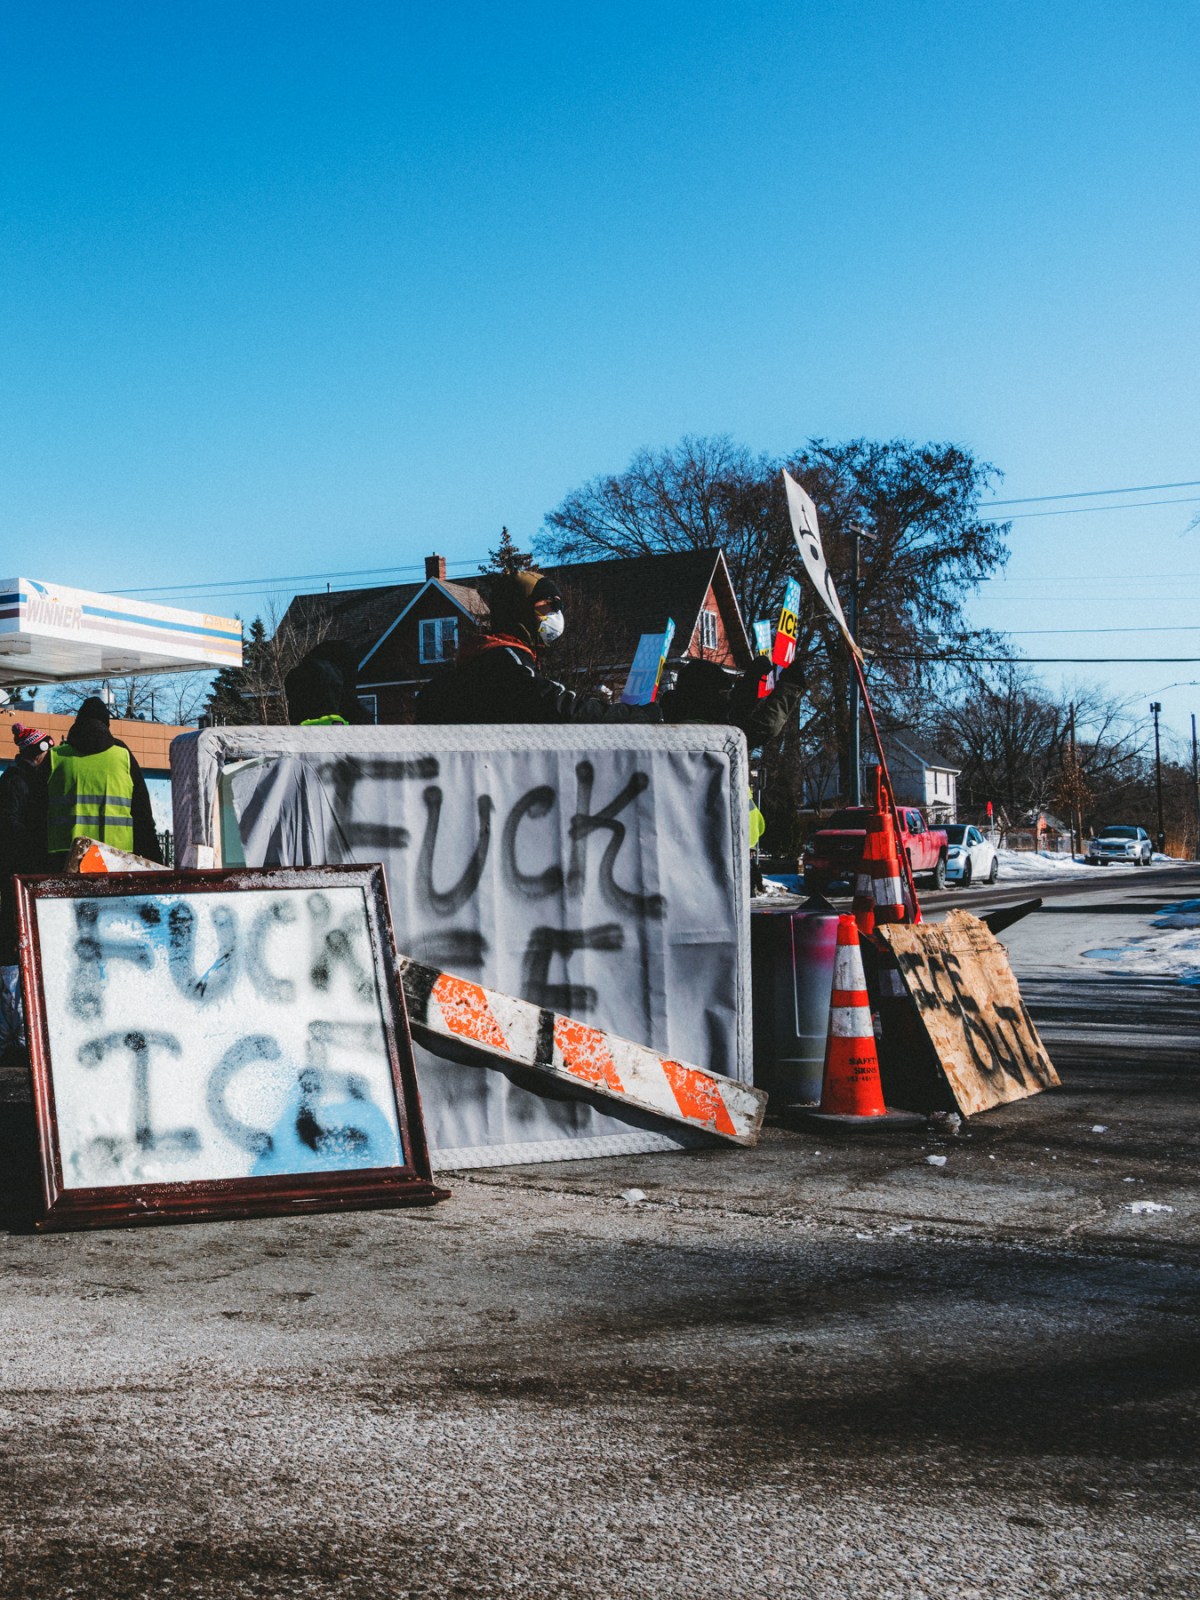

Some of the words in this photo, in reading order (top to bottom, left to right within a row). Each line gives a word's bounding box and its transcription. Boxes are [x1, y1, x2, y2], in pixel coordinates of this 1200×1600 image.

[26, 599, 82, 630] WINNER
[320, 756, 666, 919] FUCK
[66, 893, 377, 1020] FUCK
[897, 951, 980, 1019] ICE
[77, 1019, 380, 1160] ICE
